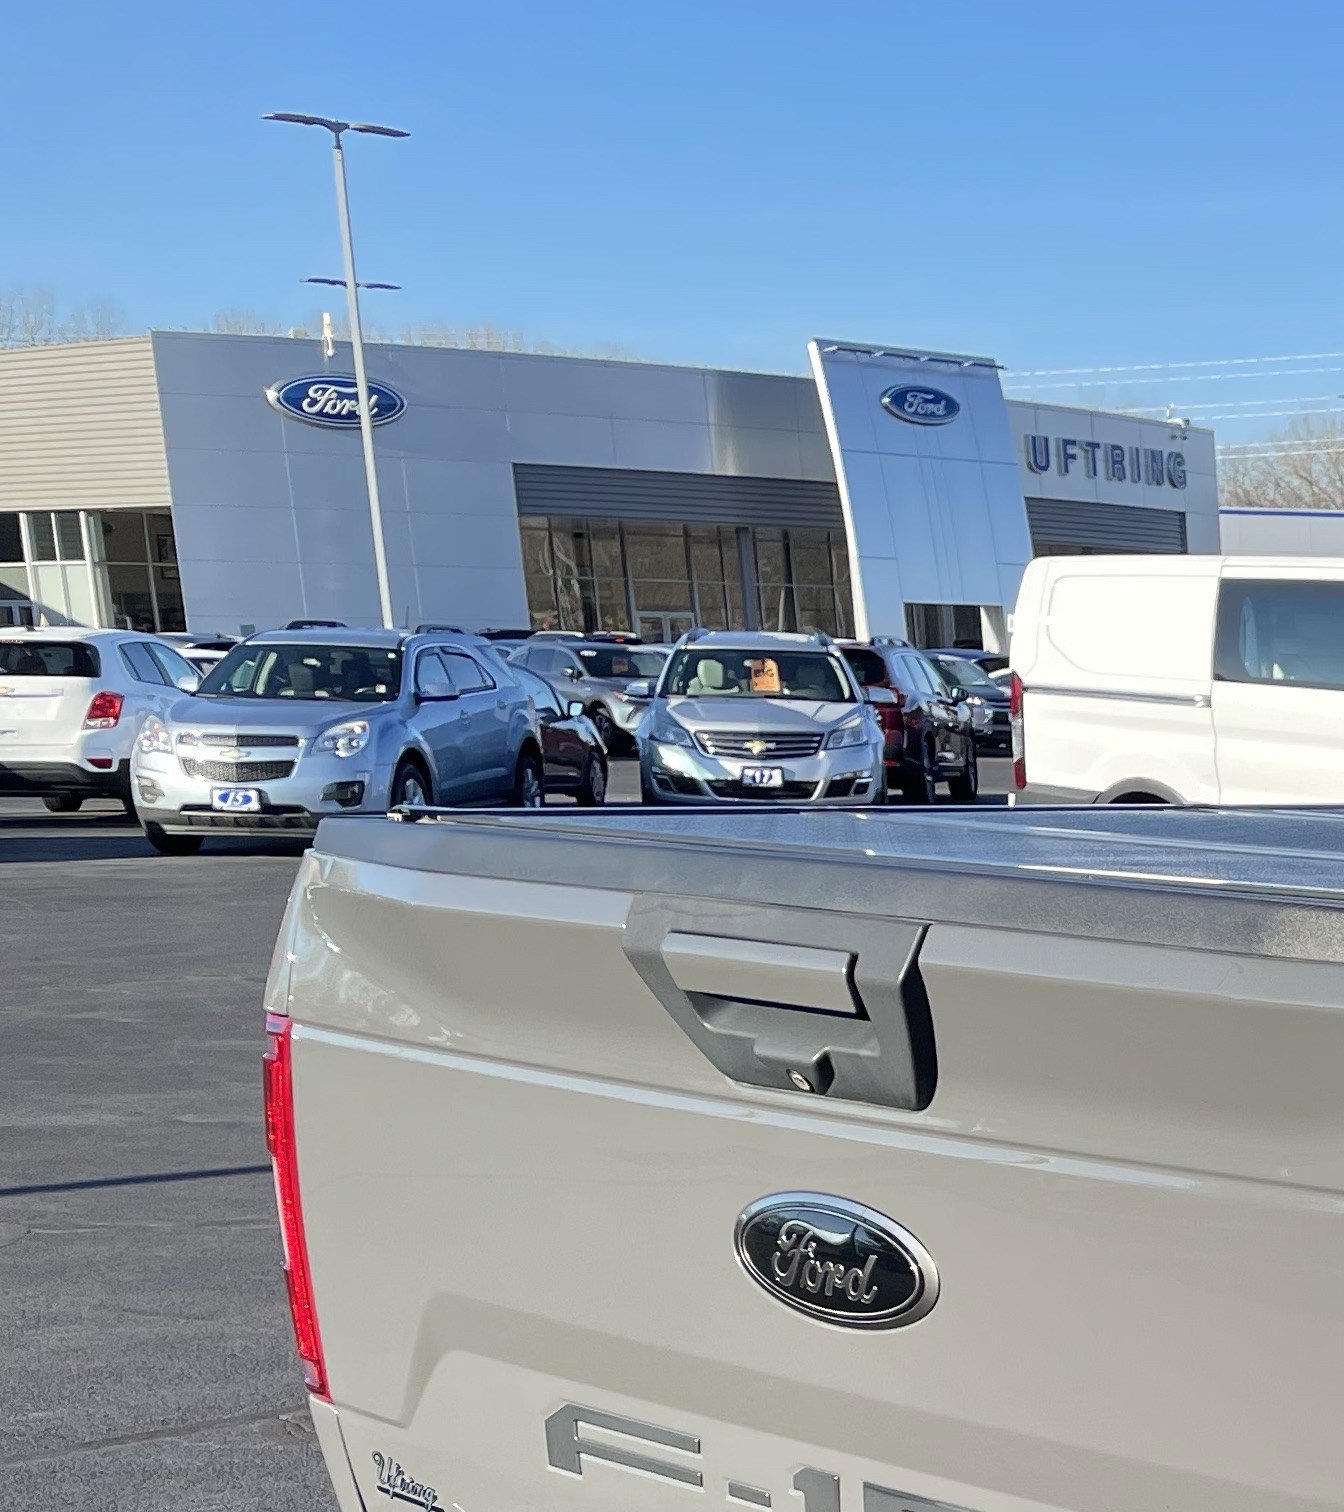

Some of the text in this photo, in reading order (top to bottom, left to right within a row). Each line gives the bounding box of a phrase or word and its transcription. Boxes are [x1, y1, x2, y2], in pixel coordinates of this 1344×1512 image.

[904, 391, 947, 416] Ford
[1026, 434, 1187, 490] UFTRING
[771, 1219, 879, 1305] Ford
